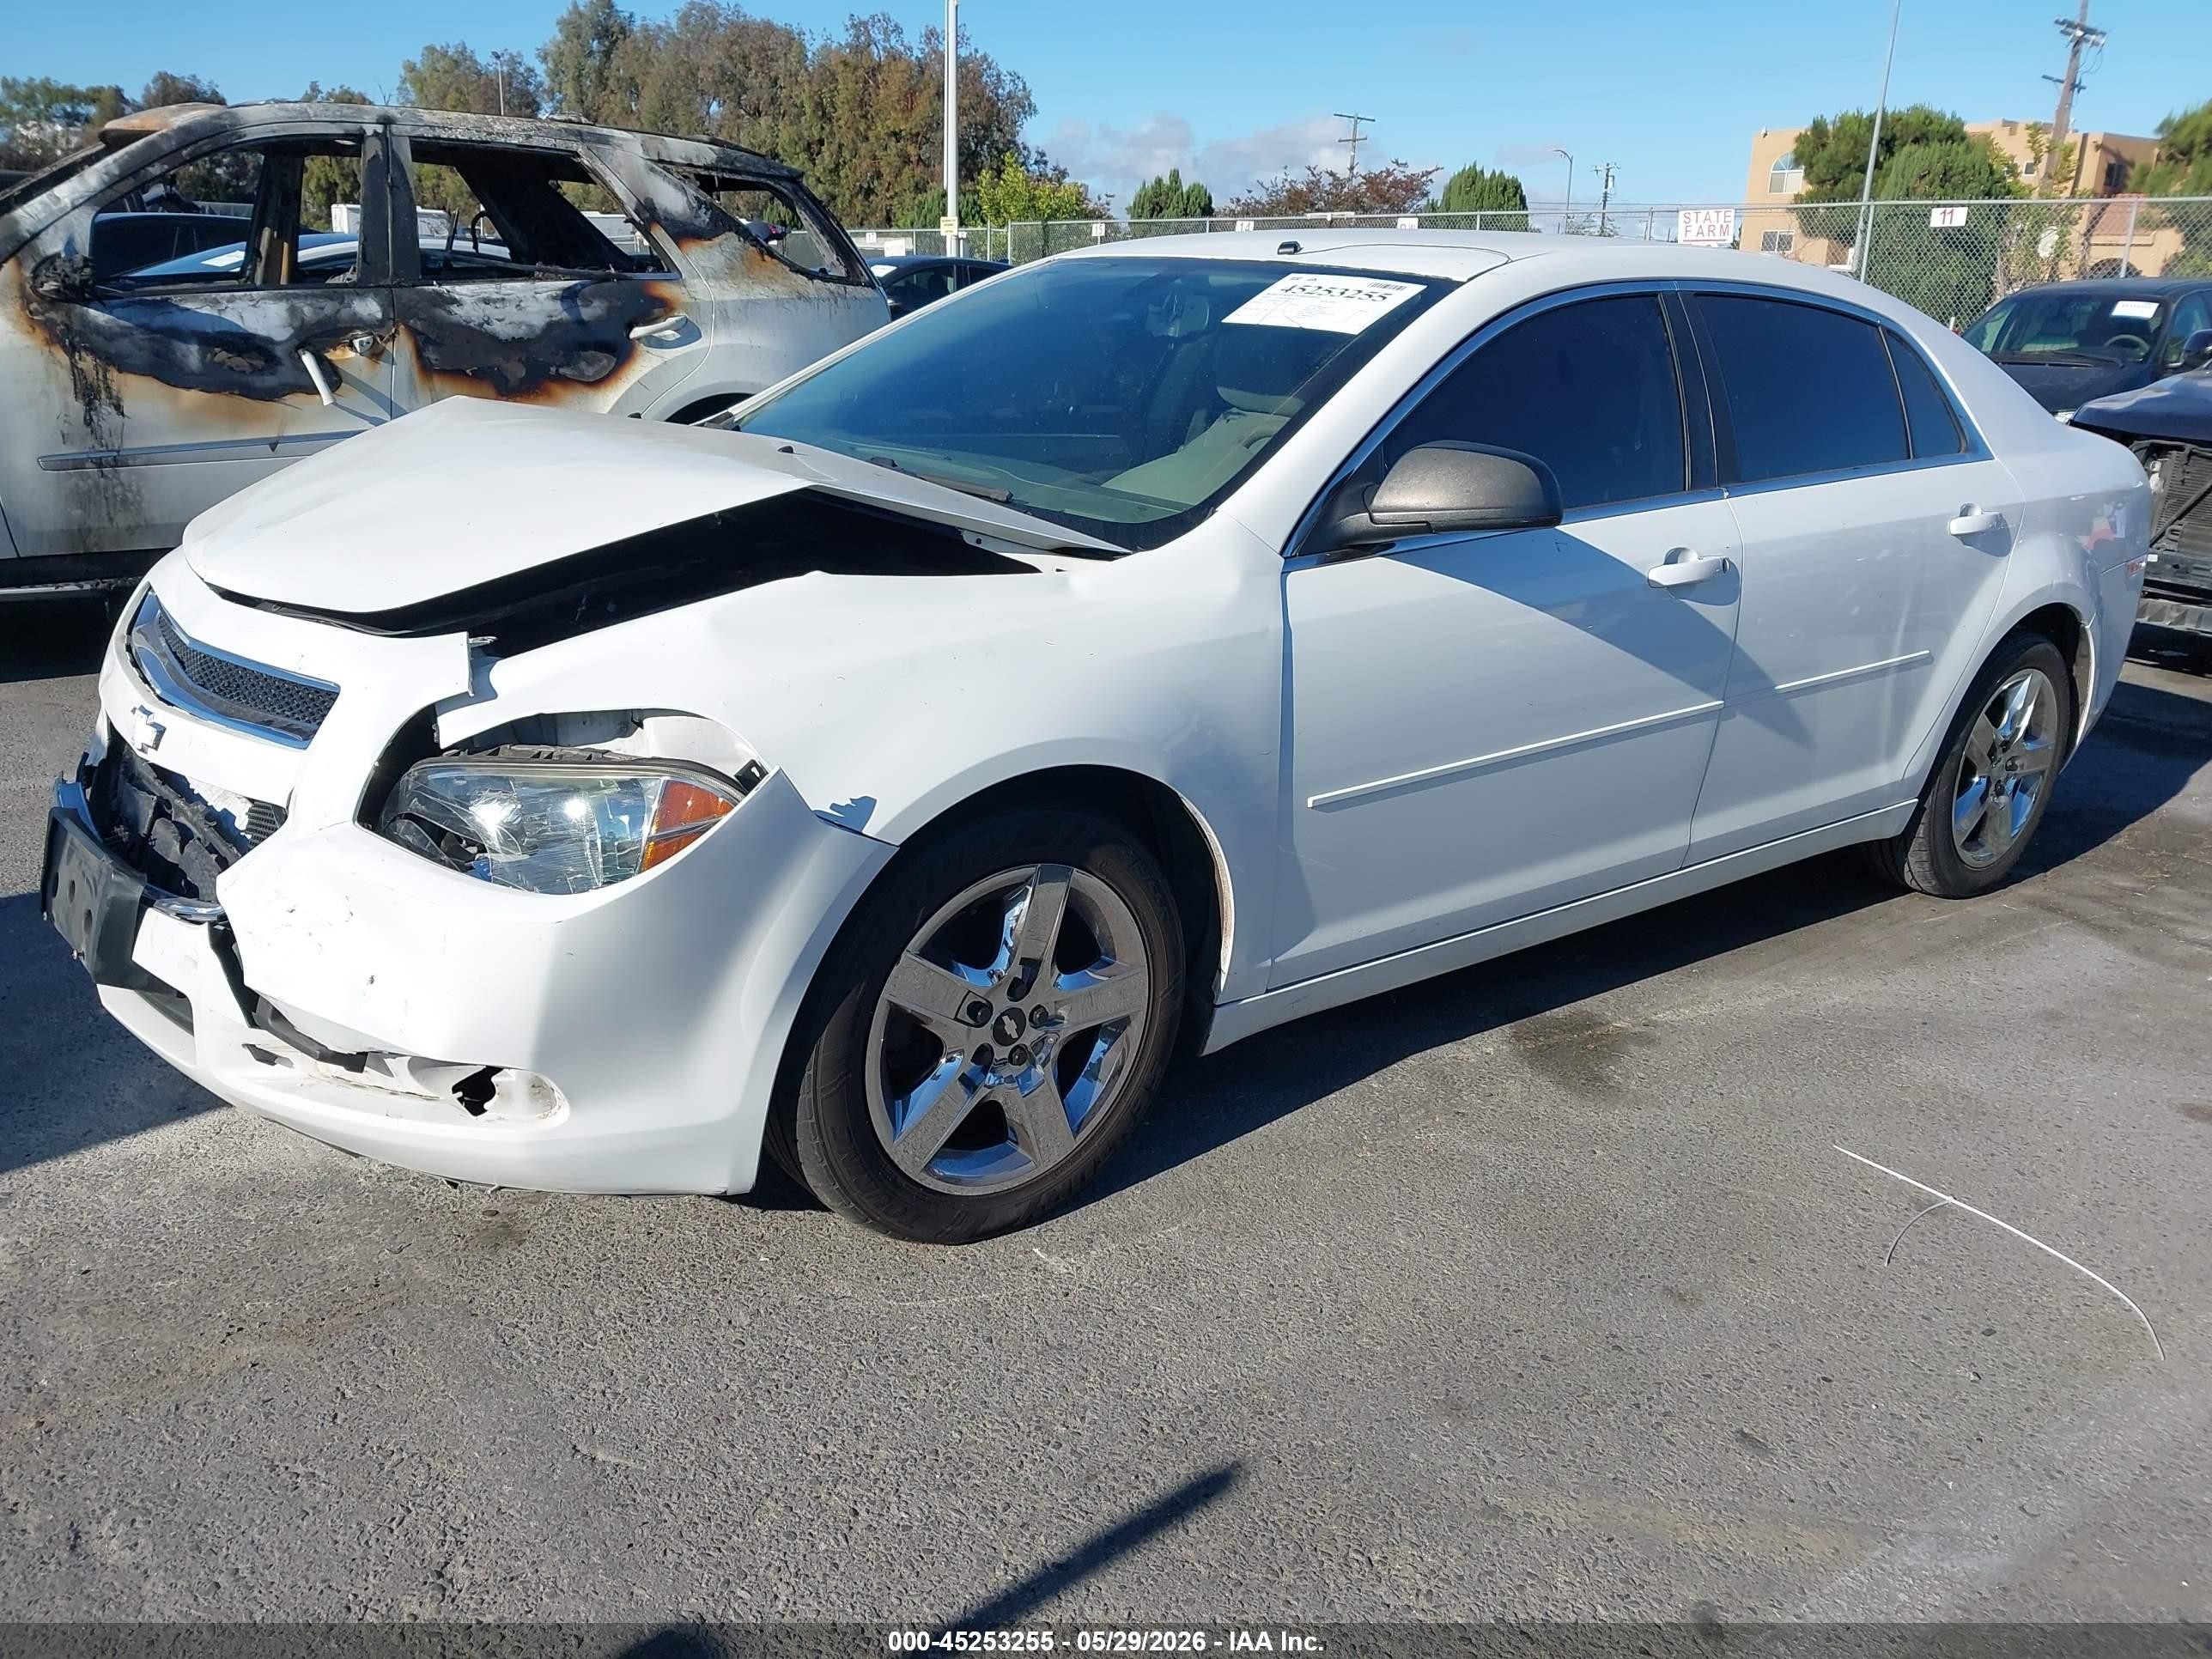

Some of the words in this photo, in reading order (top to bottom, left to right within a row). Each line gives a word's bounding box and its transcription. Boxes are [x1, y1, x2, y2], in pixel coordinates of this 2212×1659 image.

[1683, 210, 1732, 223] STATE
[1940, 208, 1954, 224] 11
[1095, 224, 1103, 234] 15
[1685, 224, 1729, 237] FARM
[1280, 284, 1393, 301] 45253255
